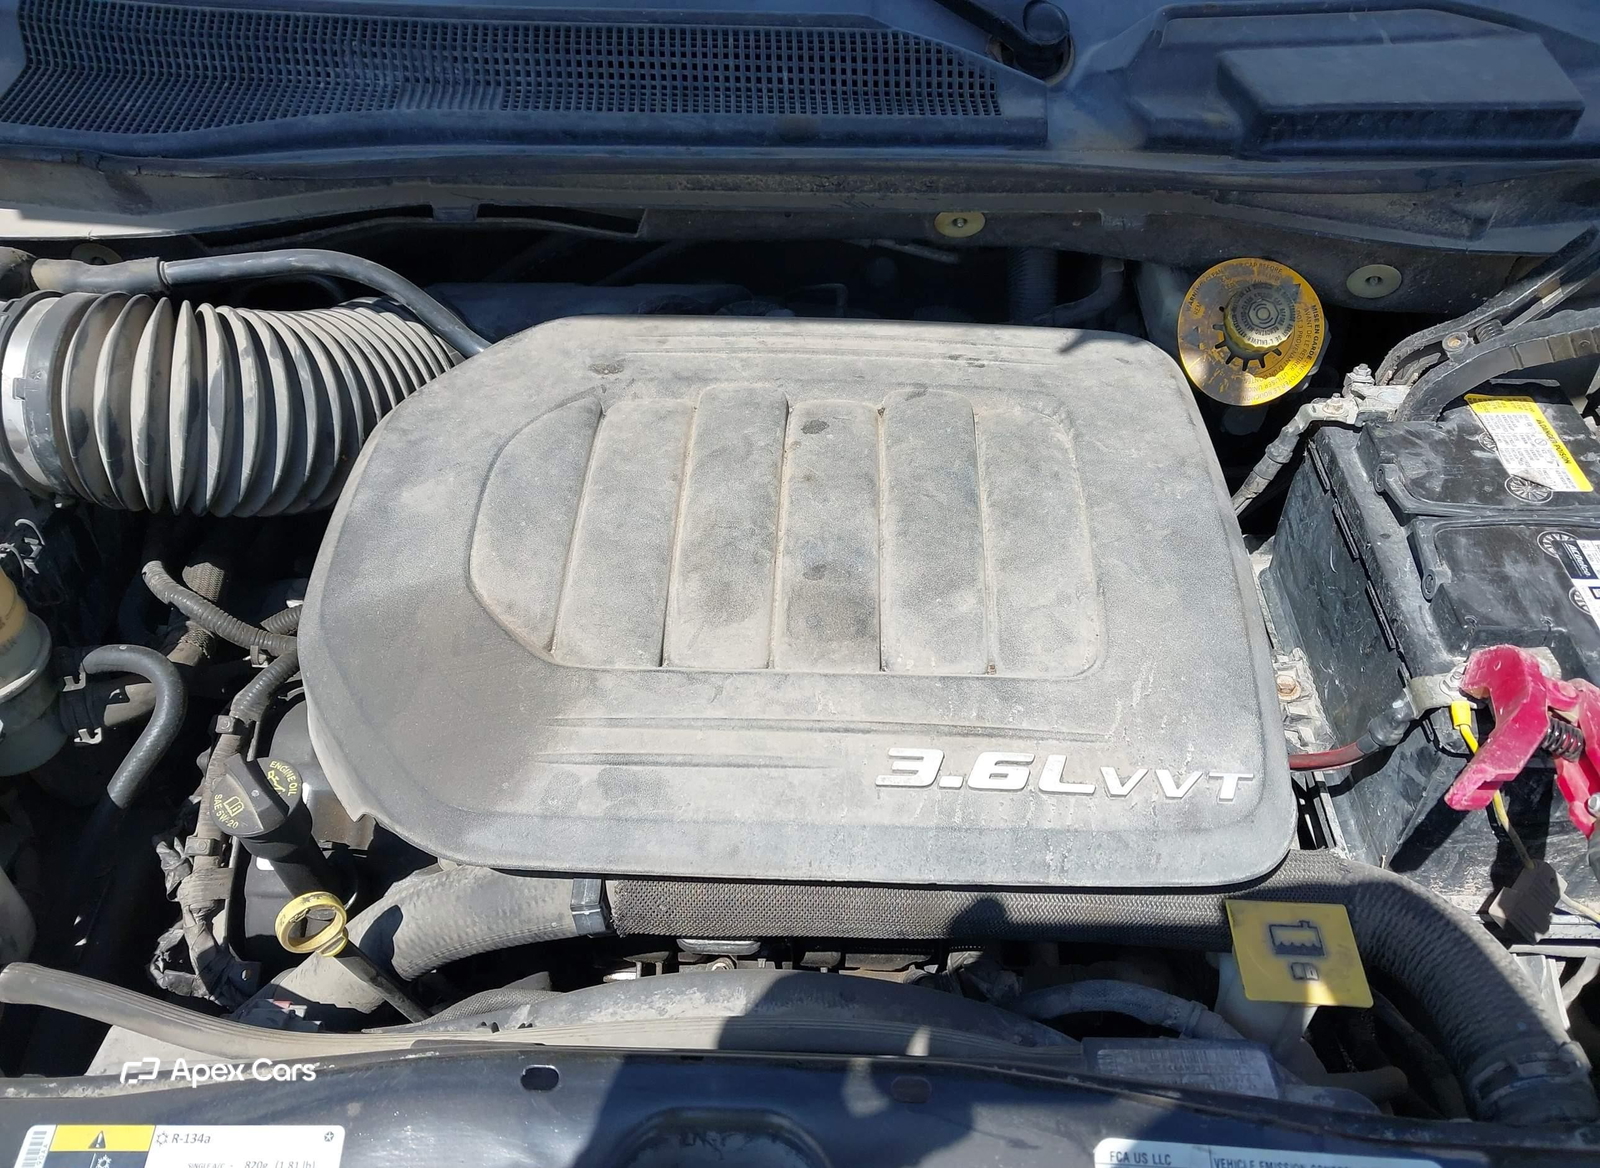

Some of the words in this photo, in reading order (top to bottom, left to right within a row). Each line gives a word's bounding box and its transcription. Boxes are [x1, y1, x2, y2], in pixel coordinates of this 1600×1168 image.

[1311, 304, 1320, 323] MISE
[1306, 329, 1312, 339] DE
[1314, 324, 1320, 334] EN
[1306, 336, 1319, 361] GARDE
[269, 760, 297, 783] ENGINE
[287, 782, 298, 797] OIL
[213, 793, 223, 811] SAE
[215, 809, 239, 830] 5W-20
[171, 1133, 211, 1145] R-134a
[1109, 1151, 1130, 1164] FCA
[1133, 1153, 1148, 1164] US
[1152, 1154, 1172, 1166] LLC
[1214, 1158, 1255, 1168] VEHICLE
